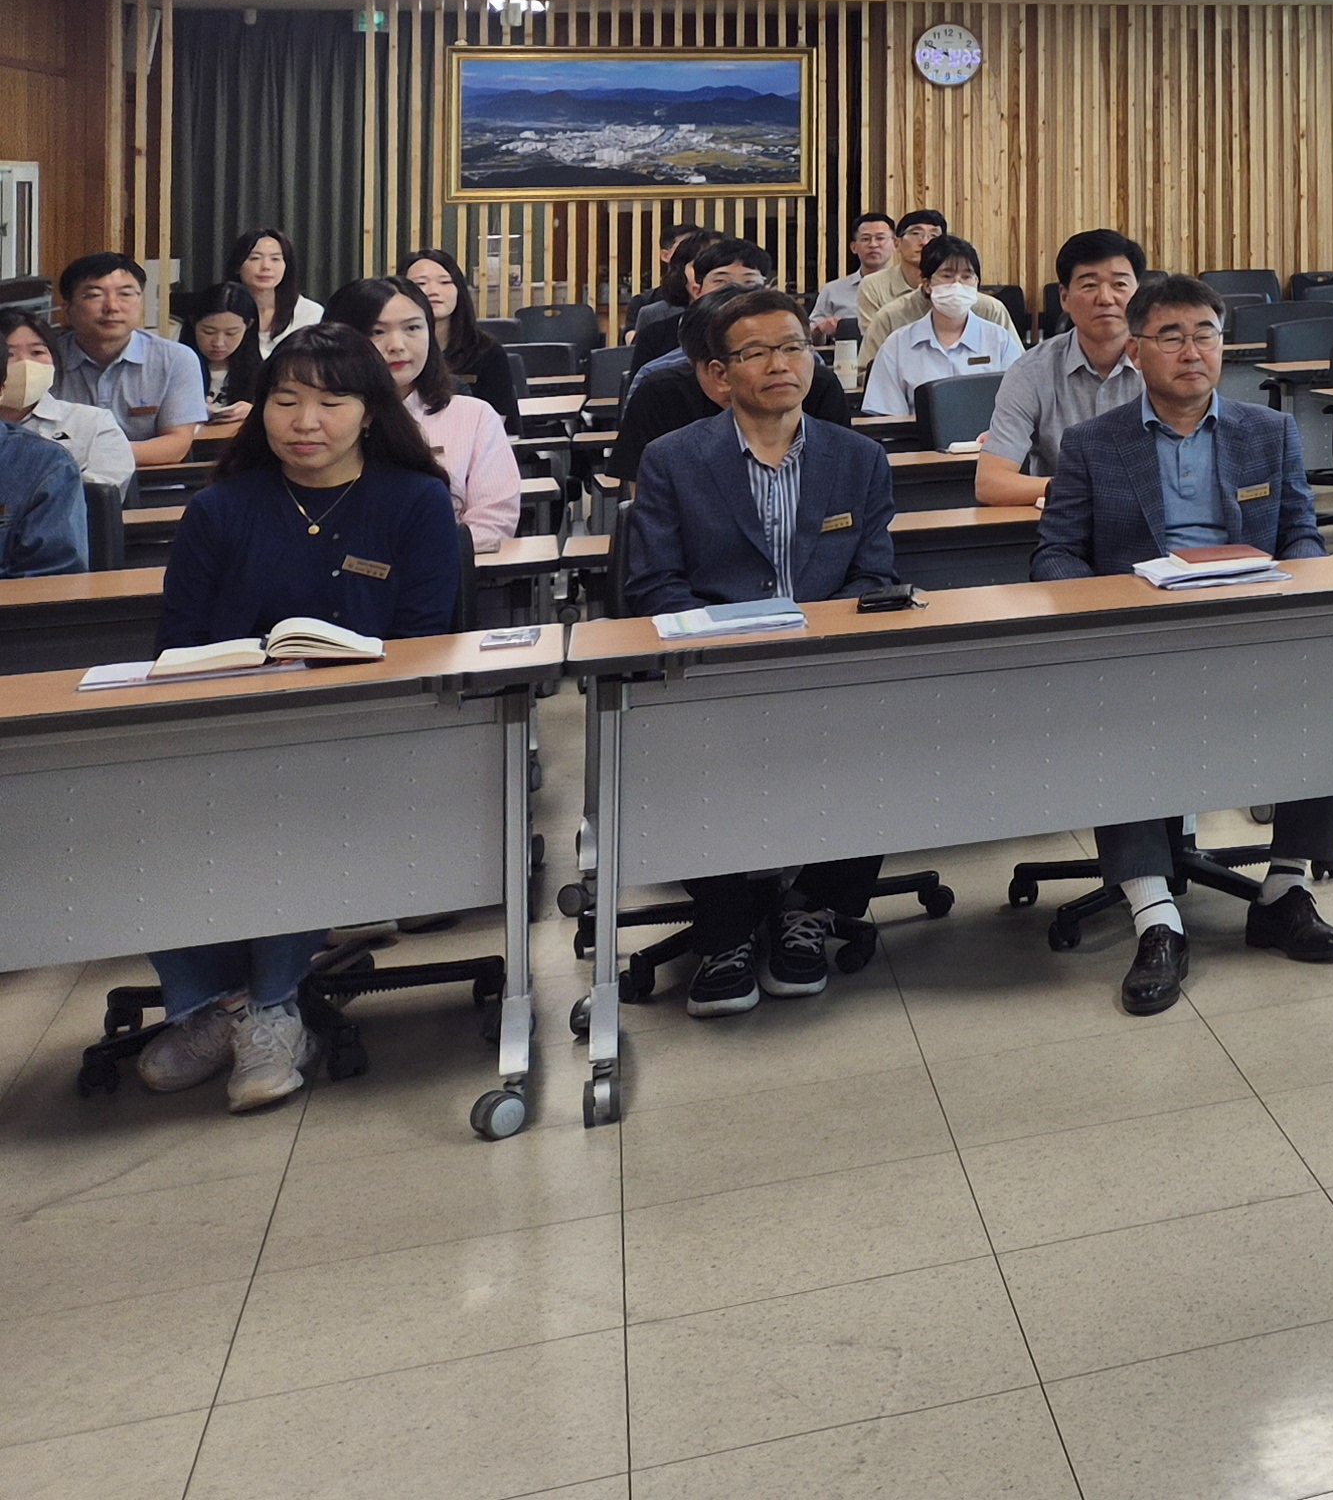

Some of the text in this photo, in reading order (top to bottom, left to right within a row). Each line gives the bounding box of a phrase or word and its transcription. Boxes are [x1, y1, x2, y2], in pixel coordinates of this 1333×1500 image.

[932, 32, 941, 40] 11
[943, 28, 954, 37] 12
[966, 40, 972, 48] 2
[923, 61, 930, 70] 8
